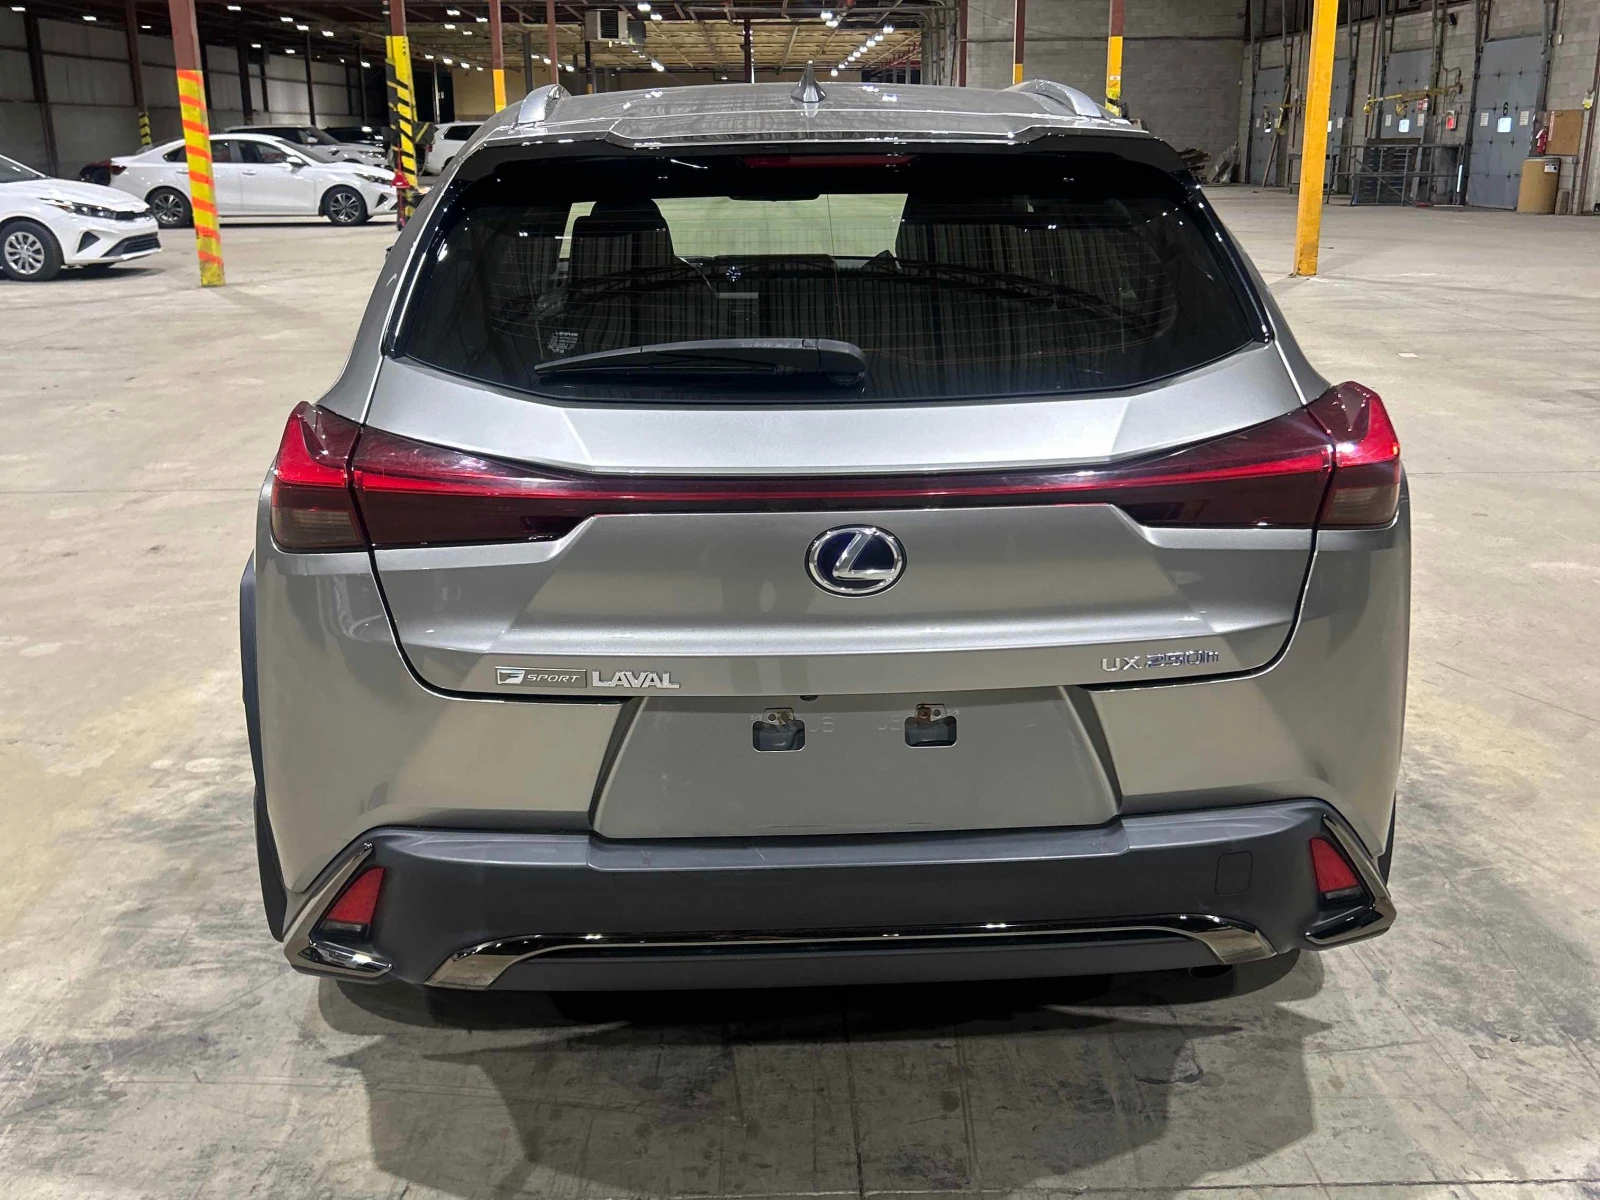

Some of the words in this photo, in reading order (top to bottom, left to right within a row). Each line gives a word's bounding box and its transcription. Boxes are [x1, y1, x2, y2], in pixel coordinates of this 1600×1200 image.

[1502, 102, 1509, 116] 6
[1102, 655, 1143, 672] UX
[1145, 649, 1220, 669] 250h
[527, 673, 581, 684] SPORT
[591, 670, 680, 690] LAVAL
